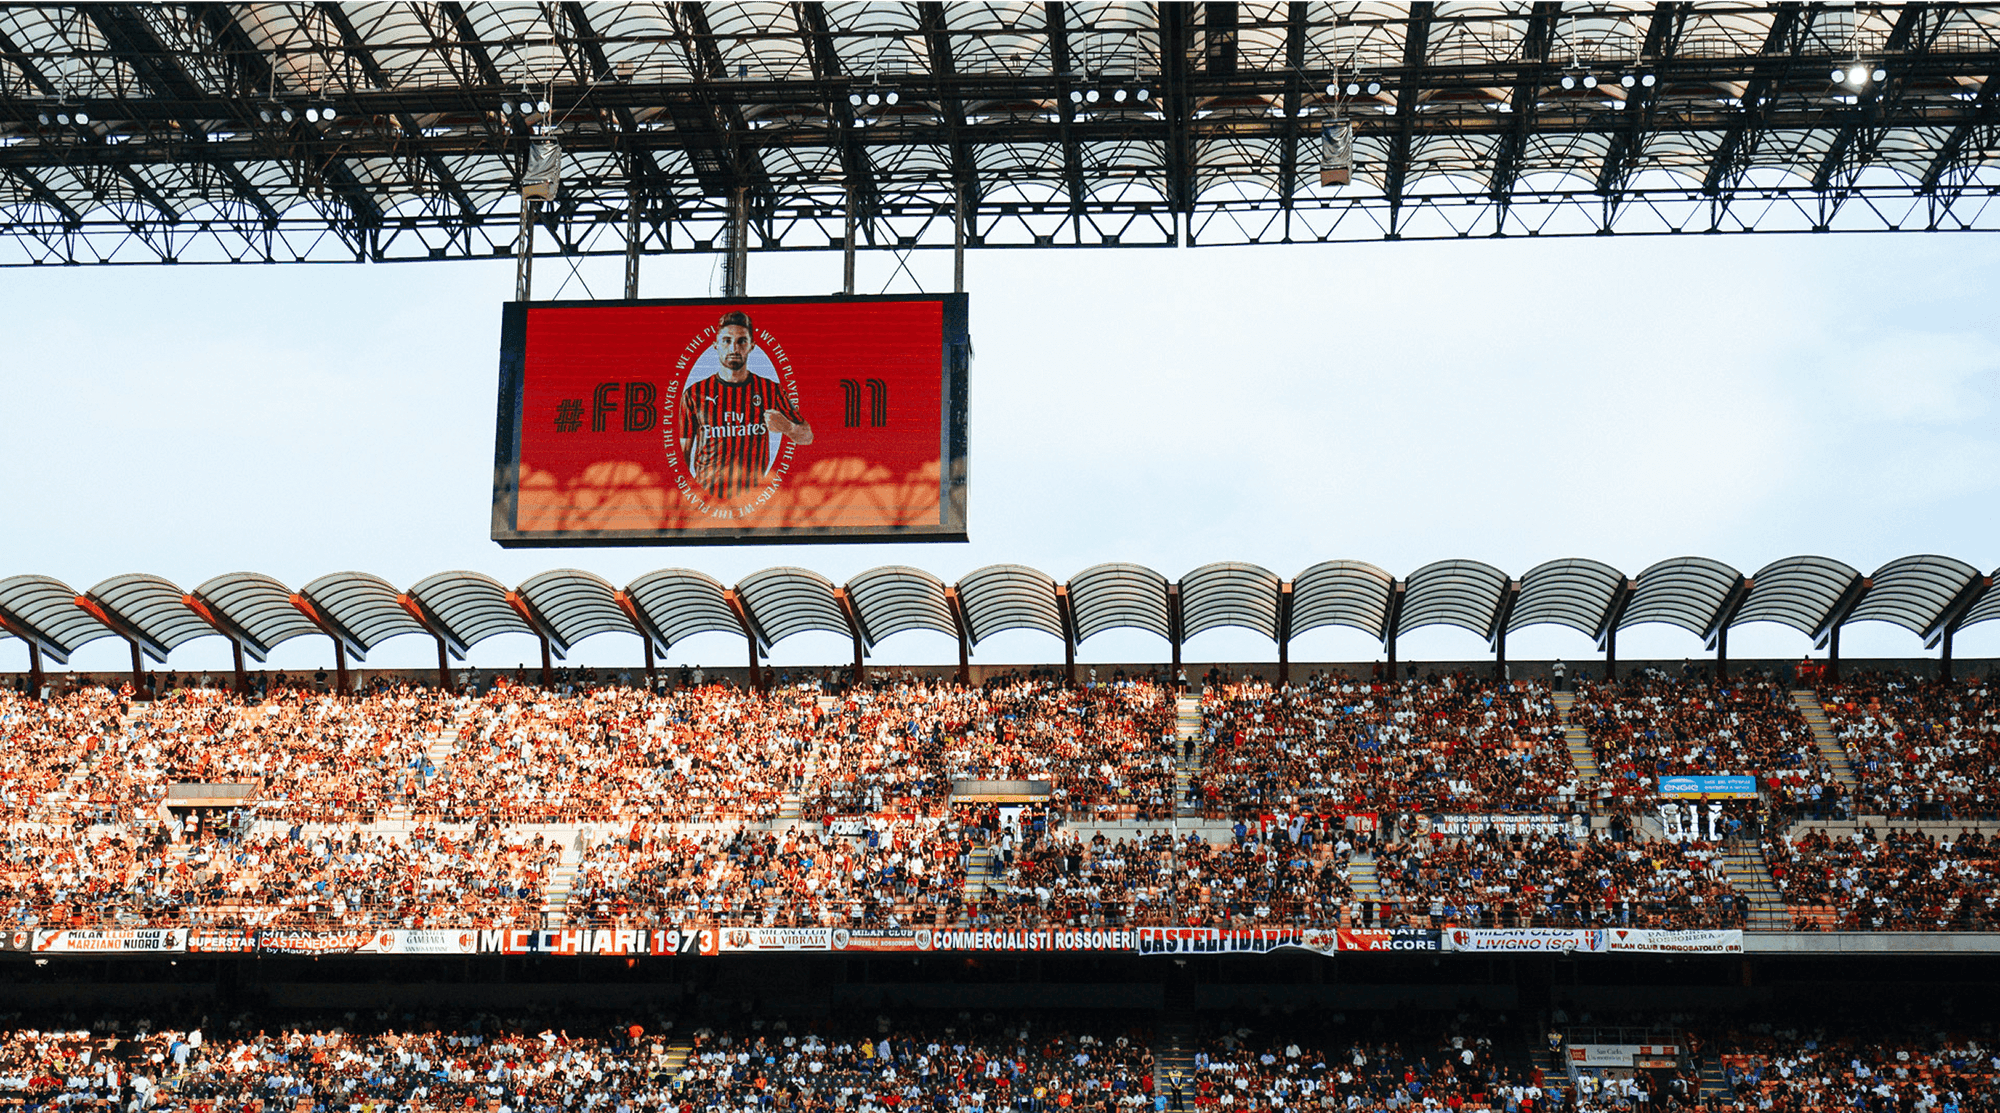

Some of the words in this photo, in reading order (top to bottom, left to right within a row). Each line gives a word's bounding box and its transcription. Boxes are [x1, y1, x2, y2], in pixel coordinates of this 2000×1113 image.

[685, 334, 705, 353] THE
[760, 330, 776, 346] WE
[772, 343, 789, 364] THE
[675, 354, 691, 370] WE
[663, 380, 679, 425] PLAYERS
[840, 378, 887, 428] 11
[724, 411, 744, 423] Fly
[663, 428, 674, 449] THE
[703, 422, 766, 439] Emirates
[666, 450, 678, 467] WE
[783, 441, 796, 461] THE
[757, 462, 789, 505] PLAYERS
[675, 475, 710, 514] PLAYERS
[262, 931, 312, 939] MILAN
[654, 929, 713, 952] 1973
[759, 936, 777, 944] VAL
[781, 936, 826, 944] VIBRATA
[851, 929, 885, 937] MILAN
[888, 929, 914, 937] CLUB
[932, 931, 1051, 949] COMMERCIALISTI
[1055, 931, 1135, 949] ROSSONERI
[67, 939, 122, 949] MARZIANO
[123, 939, 160, 949] NUORO
[188, 937, 256, 947] SUPERSTAR
[261, 937, 357, 949] CASTENEDOLO
[1369, 940, 1436, 950] ARCORE
[1476, 939, 1541, 949] LIVIGNO
